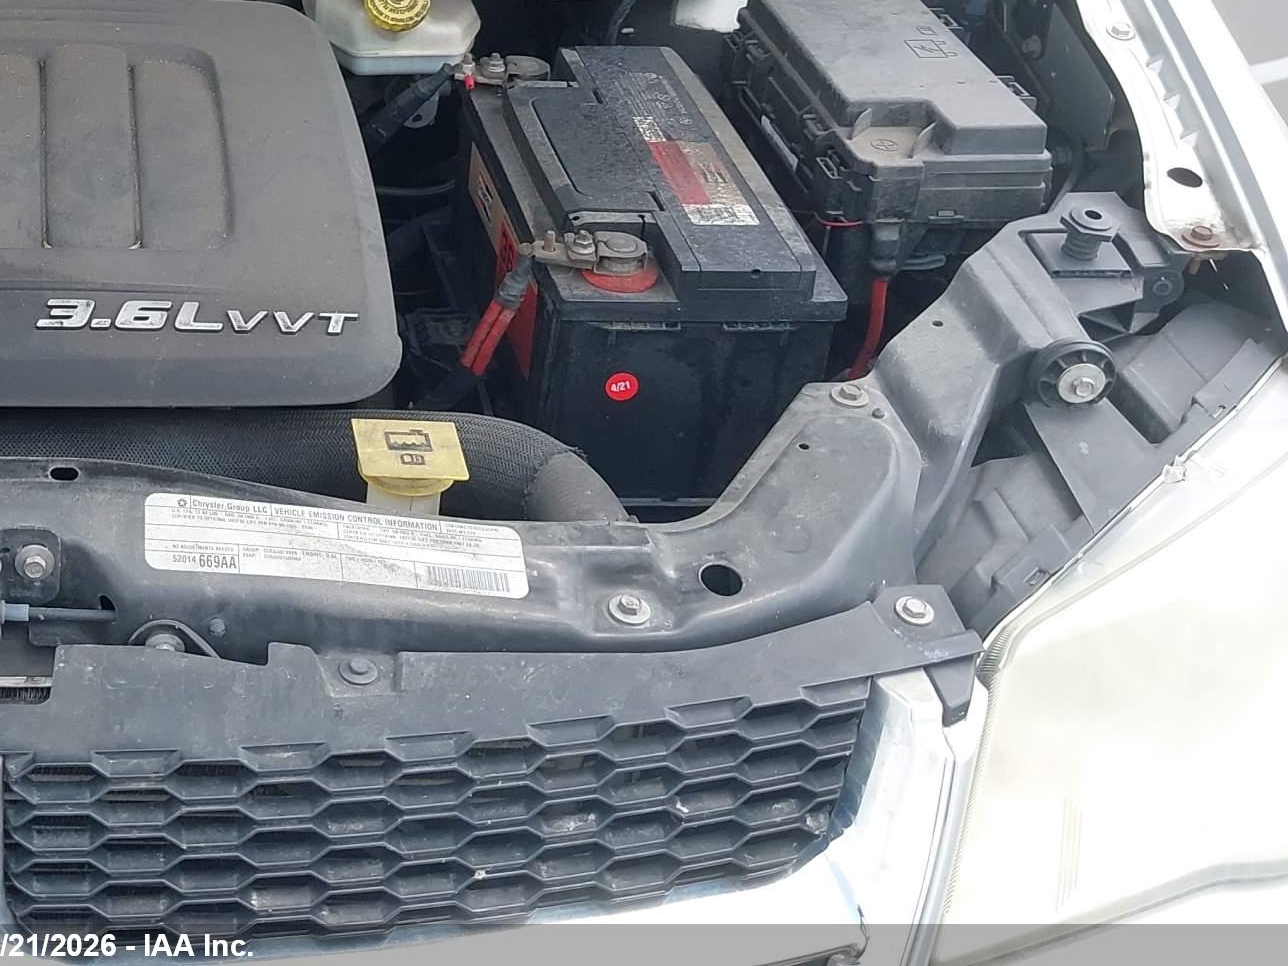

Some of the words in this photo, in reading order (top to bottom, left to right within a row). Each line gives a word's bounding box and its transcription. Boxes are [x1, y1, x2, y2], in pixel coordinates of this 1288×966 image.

[36, 298, 224, 332] 3.6L
[226, 309, 360, 336] VVT
[610, 381, 631, 392] 4/21
[192, 499, 224, 510] Chrysler
[227, 502, 251, 513] Group
[253, 506, 268, 514] LLC
[274, 507, 306, 518] VEHICLE
[309, 511, 344, 522] EMISSION
[348, 515, 382, 526] CONTROL
[385, 518, 438, 532] INFORMATION
[172, 554, 196, 563] 52014
[199, 554, 237, 569] 669AA
